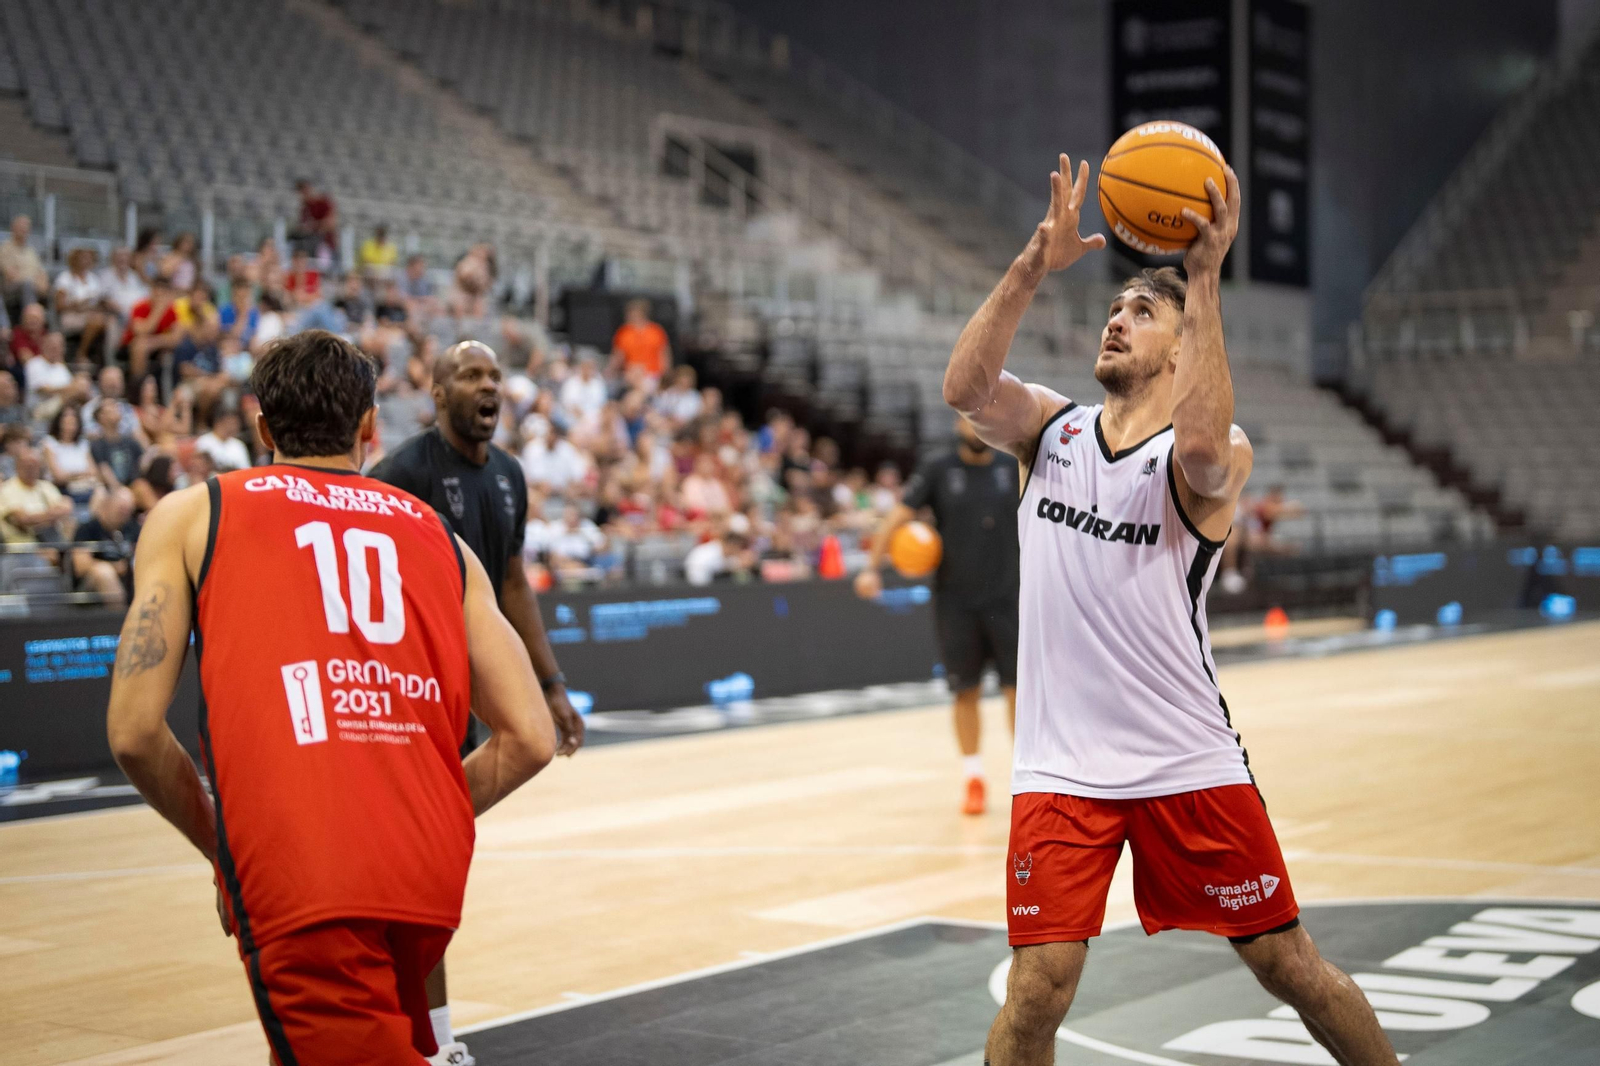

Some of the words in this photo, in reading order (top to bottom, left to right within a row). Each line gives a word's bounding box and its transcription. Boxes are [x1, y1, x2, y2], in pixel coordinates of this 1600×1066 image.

[1148, 211, 1183, 229] acb
[1047, 450, 1071, 468] vive
[244, 474, 318, 494] CAJA
[325, 483, 423, 519] RURAL
[286, 488, 394, 516] GRANADA
[294, 521, 406, 644] 10
[331, 688, 392, 717] 2031
[1204, 879, 1259, 896] Granada
[1012, 904, 1040, 916] vive
[1218, 889, 1262, 911] Digital
